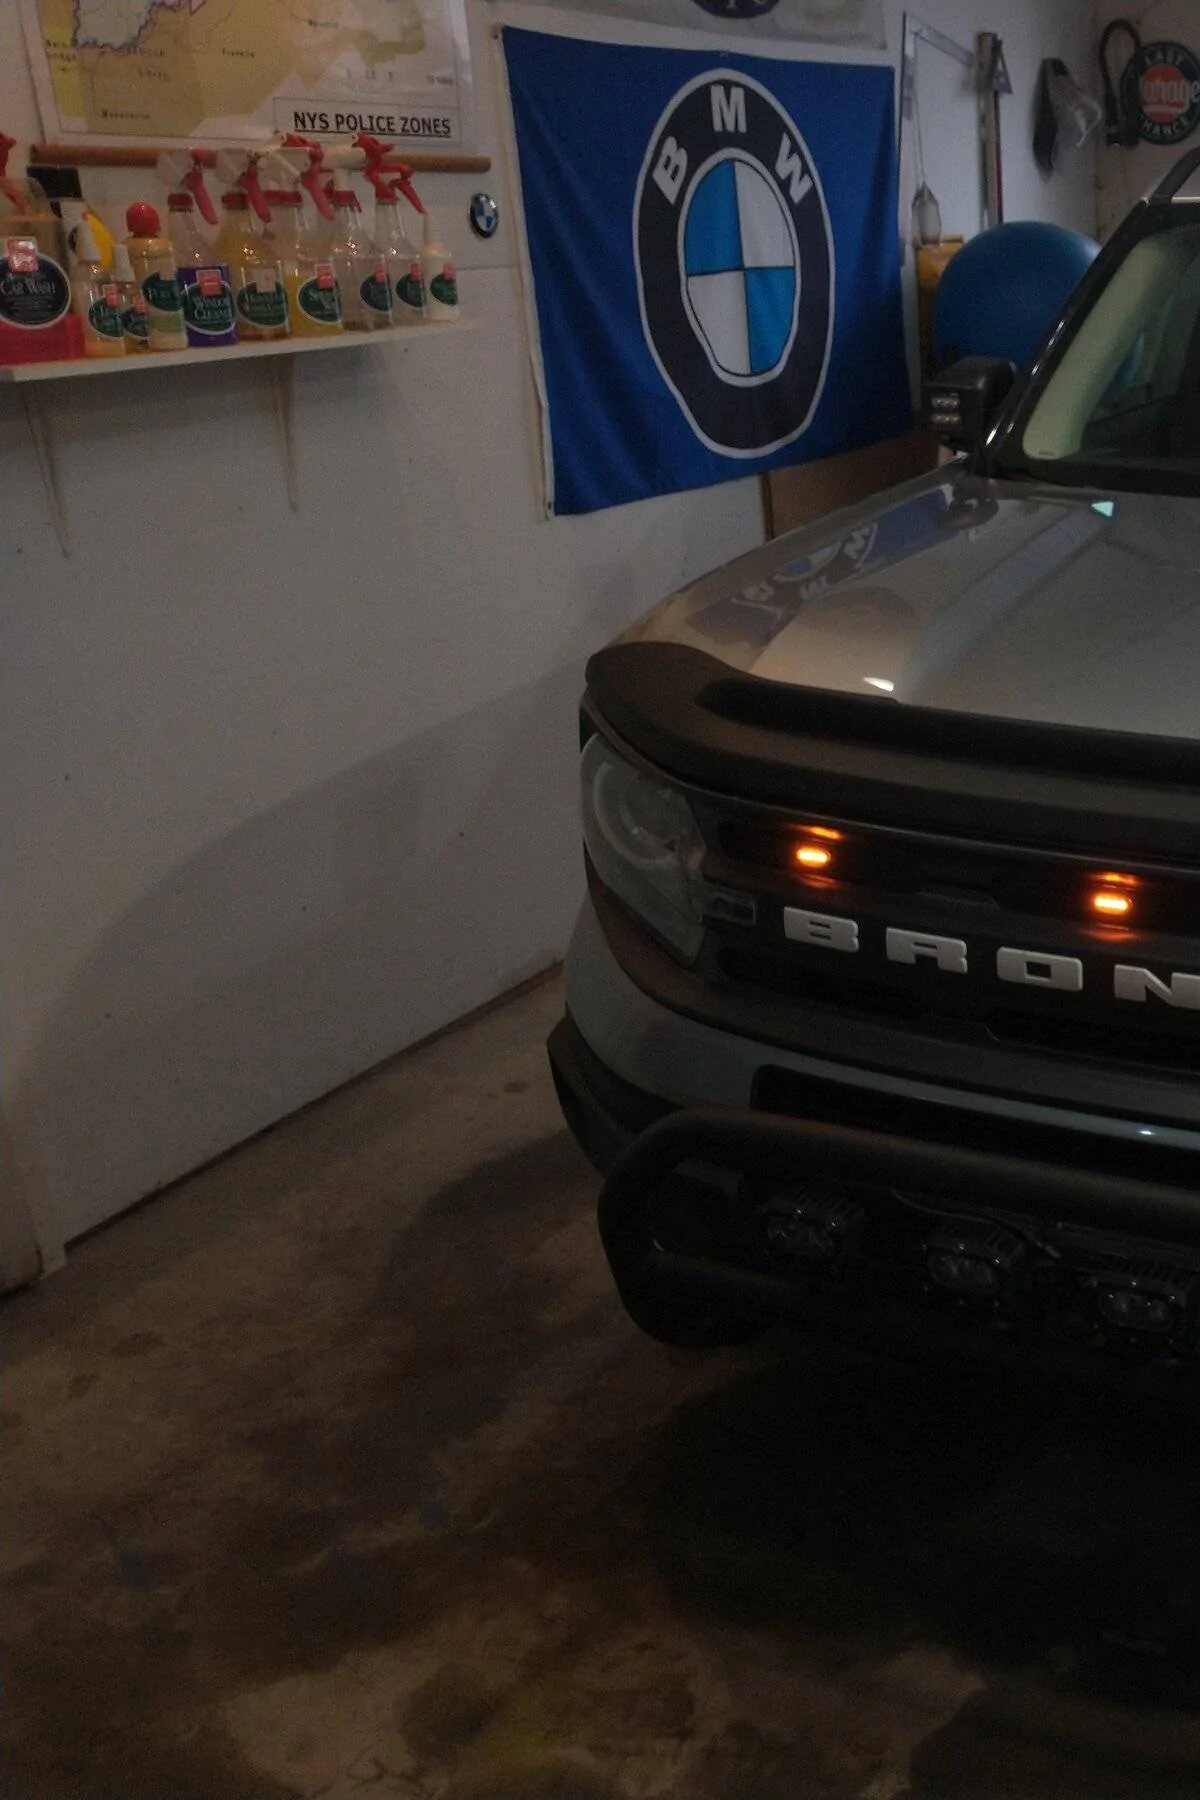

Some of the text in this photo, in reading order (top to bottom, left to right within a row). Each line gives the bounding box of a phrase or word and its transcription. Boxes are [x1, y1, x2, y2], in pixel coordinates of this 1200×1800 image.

[294, 112, 452, 135] NYS POLICE ZONES
[652, 84, 814, 205] BMW
